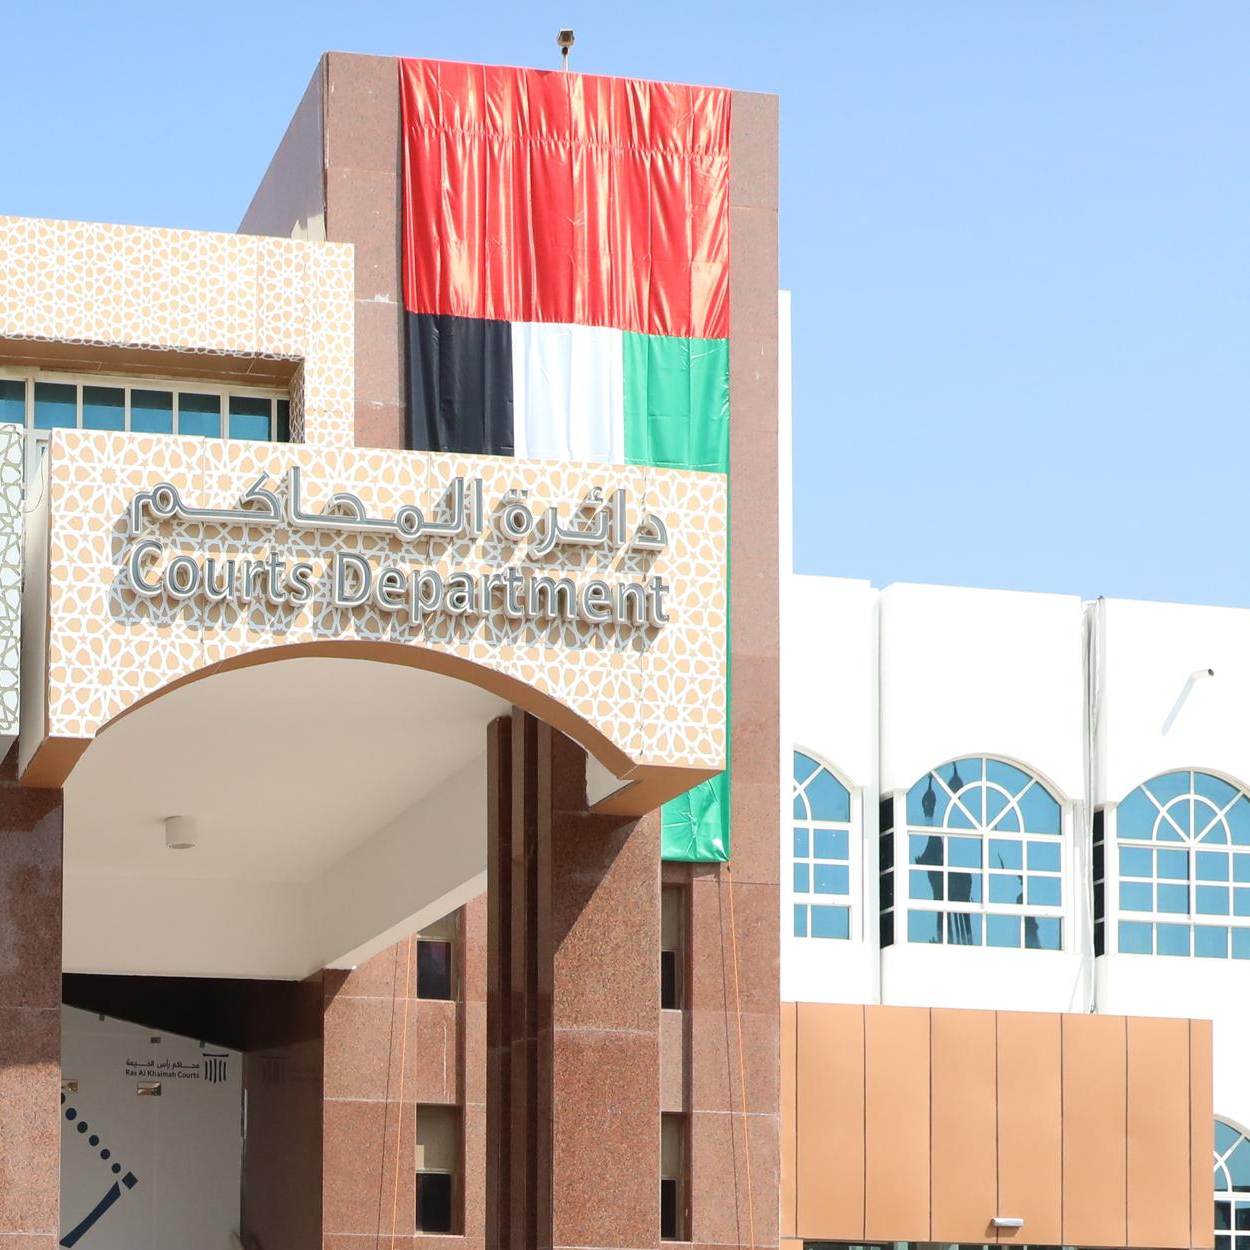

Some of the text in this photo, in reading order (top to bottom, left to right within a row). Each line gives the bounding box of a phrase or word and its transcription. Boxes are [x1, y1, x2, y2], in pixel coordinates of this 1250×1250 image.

[130, 465, 668, 559] دائرة المحاكم
[126, 538, 670, 629] Courts Department
[125, 1069, 200, 1079] Ras Al Khaimah Courts
